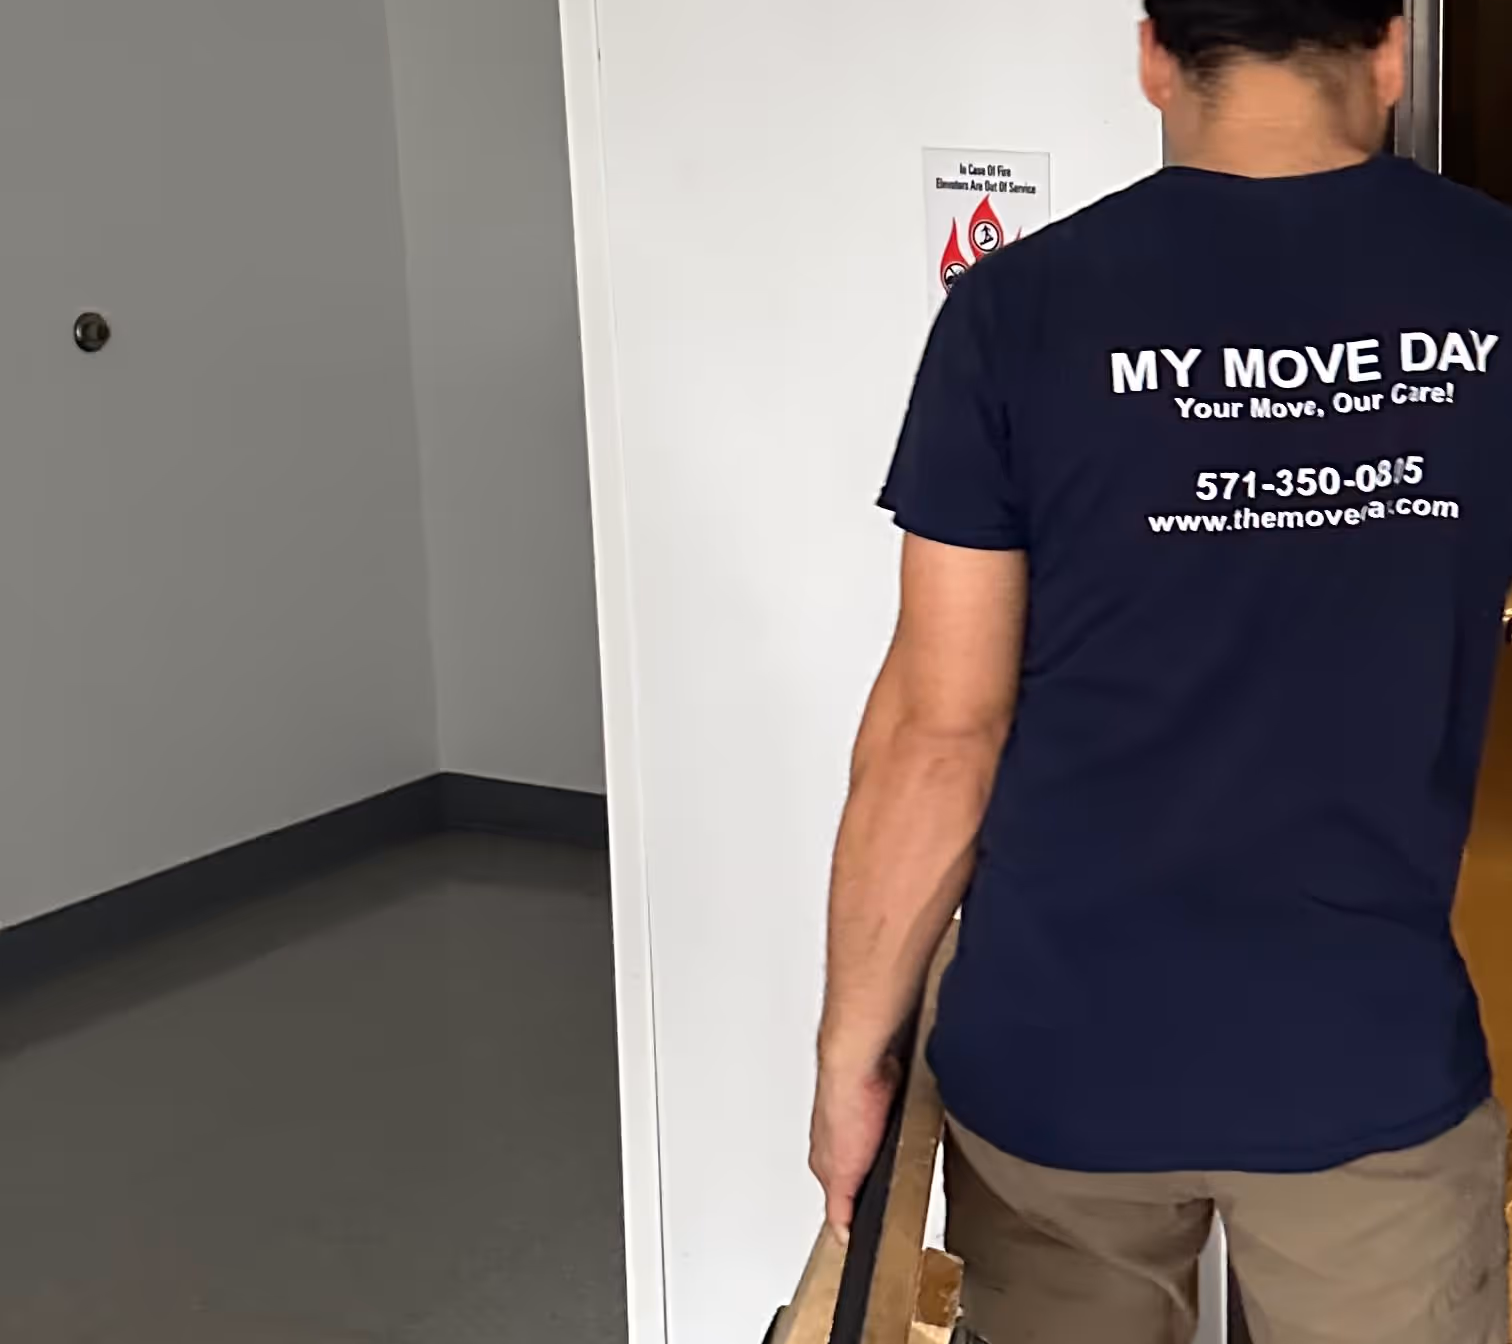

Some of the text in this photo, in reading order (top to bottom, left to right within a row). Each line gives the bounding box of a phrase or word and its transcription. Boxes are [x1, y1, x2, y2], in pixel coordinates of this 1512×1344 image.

[959, 162, 1011, 177] In Case Of Fire
[970, 179, 983, 191] Are
[984, 180, 998, 192] Out
[999, 180, 1008, 192] Of
[1009, 181, 1036, 194] Service
[1111, 329, 1499, 394] MY MOVE DAY
[1174, 382, 1455, 419] Your Move, Our Care!
